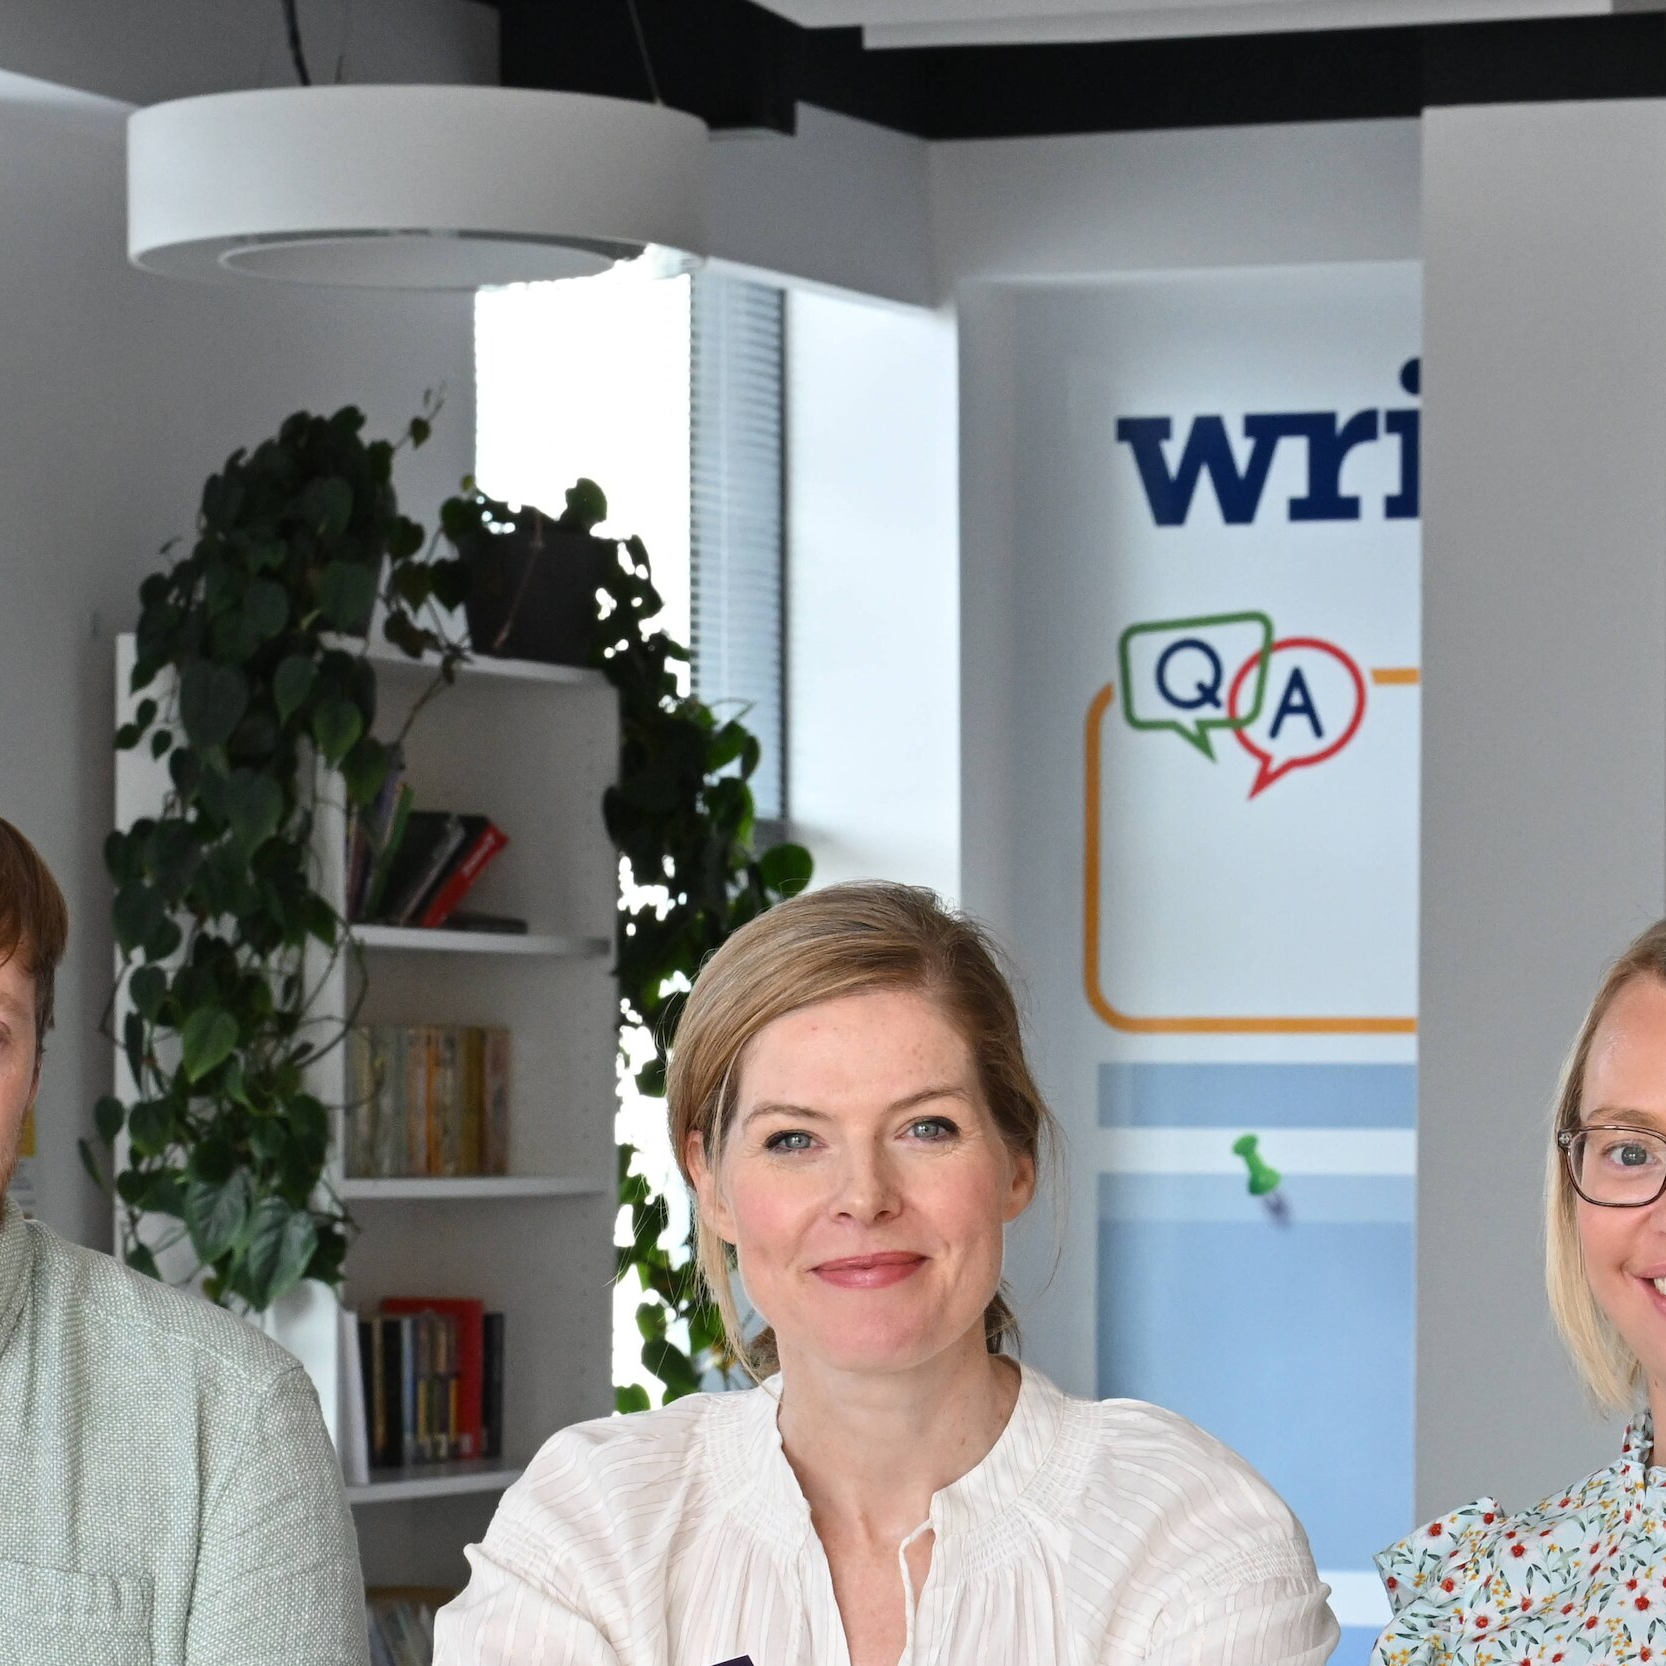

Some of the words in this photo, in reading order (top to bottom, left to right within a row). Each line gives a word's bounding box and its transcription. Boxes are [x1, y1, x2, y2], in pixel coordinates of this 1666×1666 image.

[1116, 358, 1420, 527] wri
[1156, 638, 1223, 710] Q
[1269, 667, 1323, 740] A
